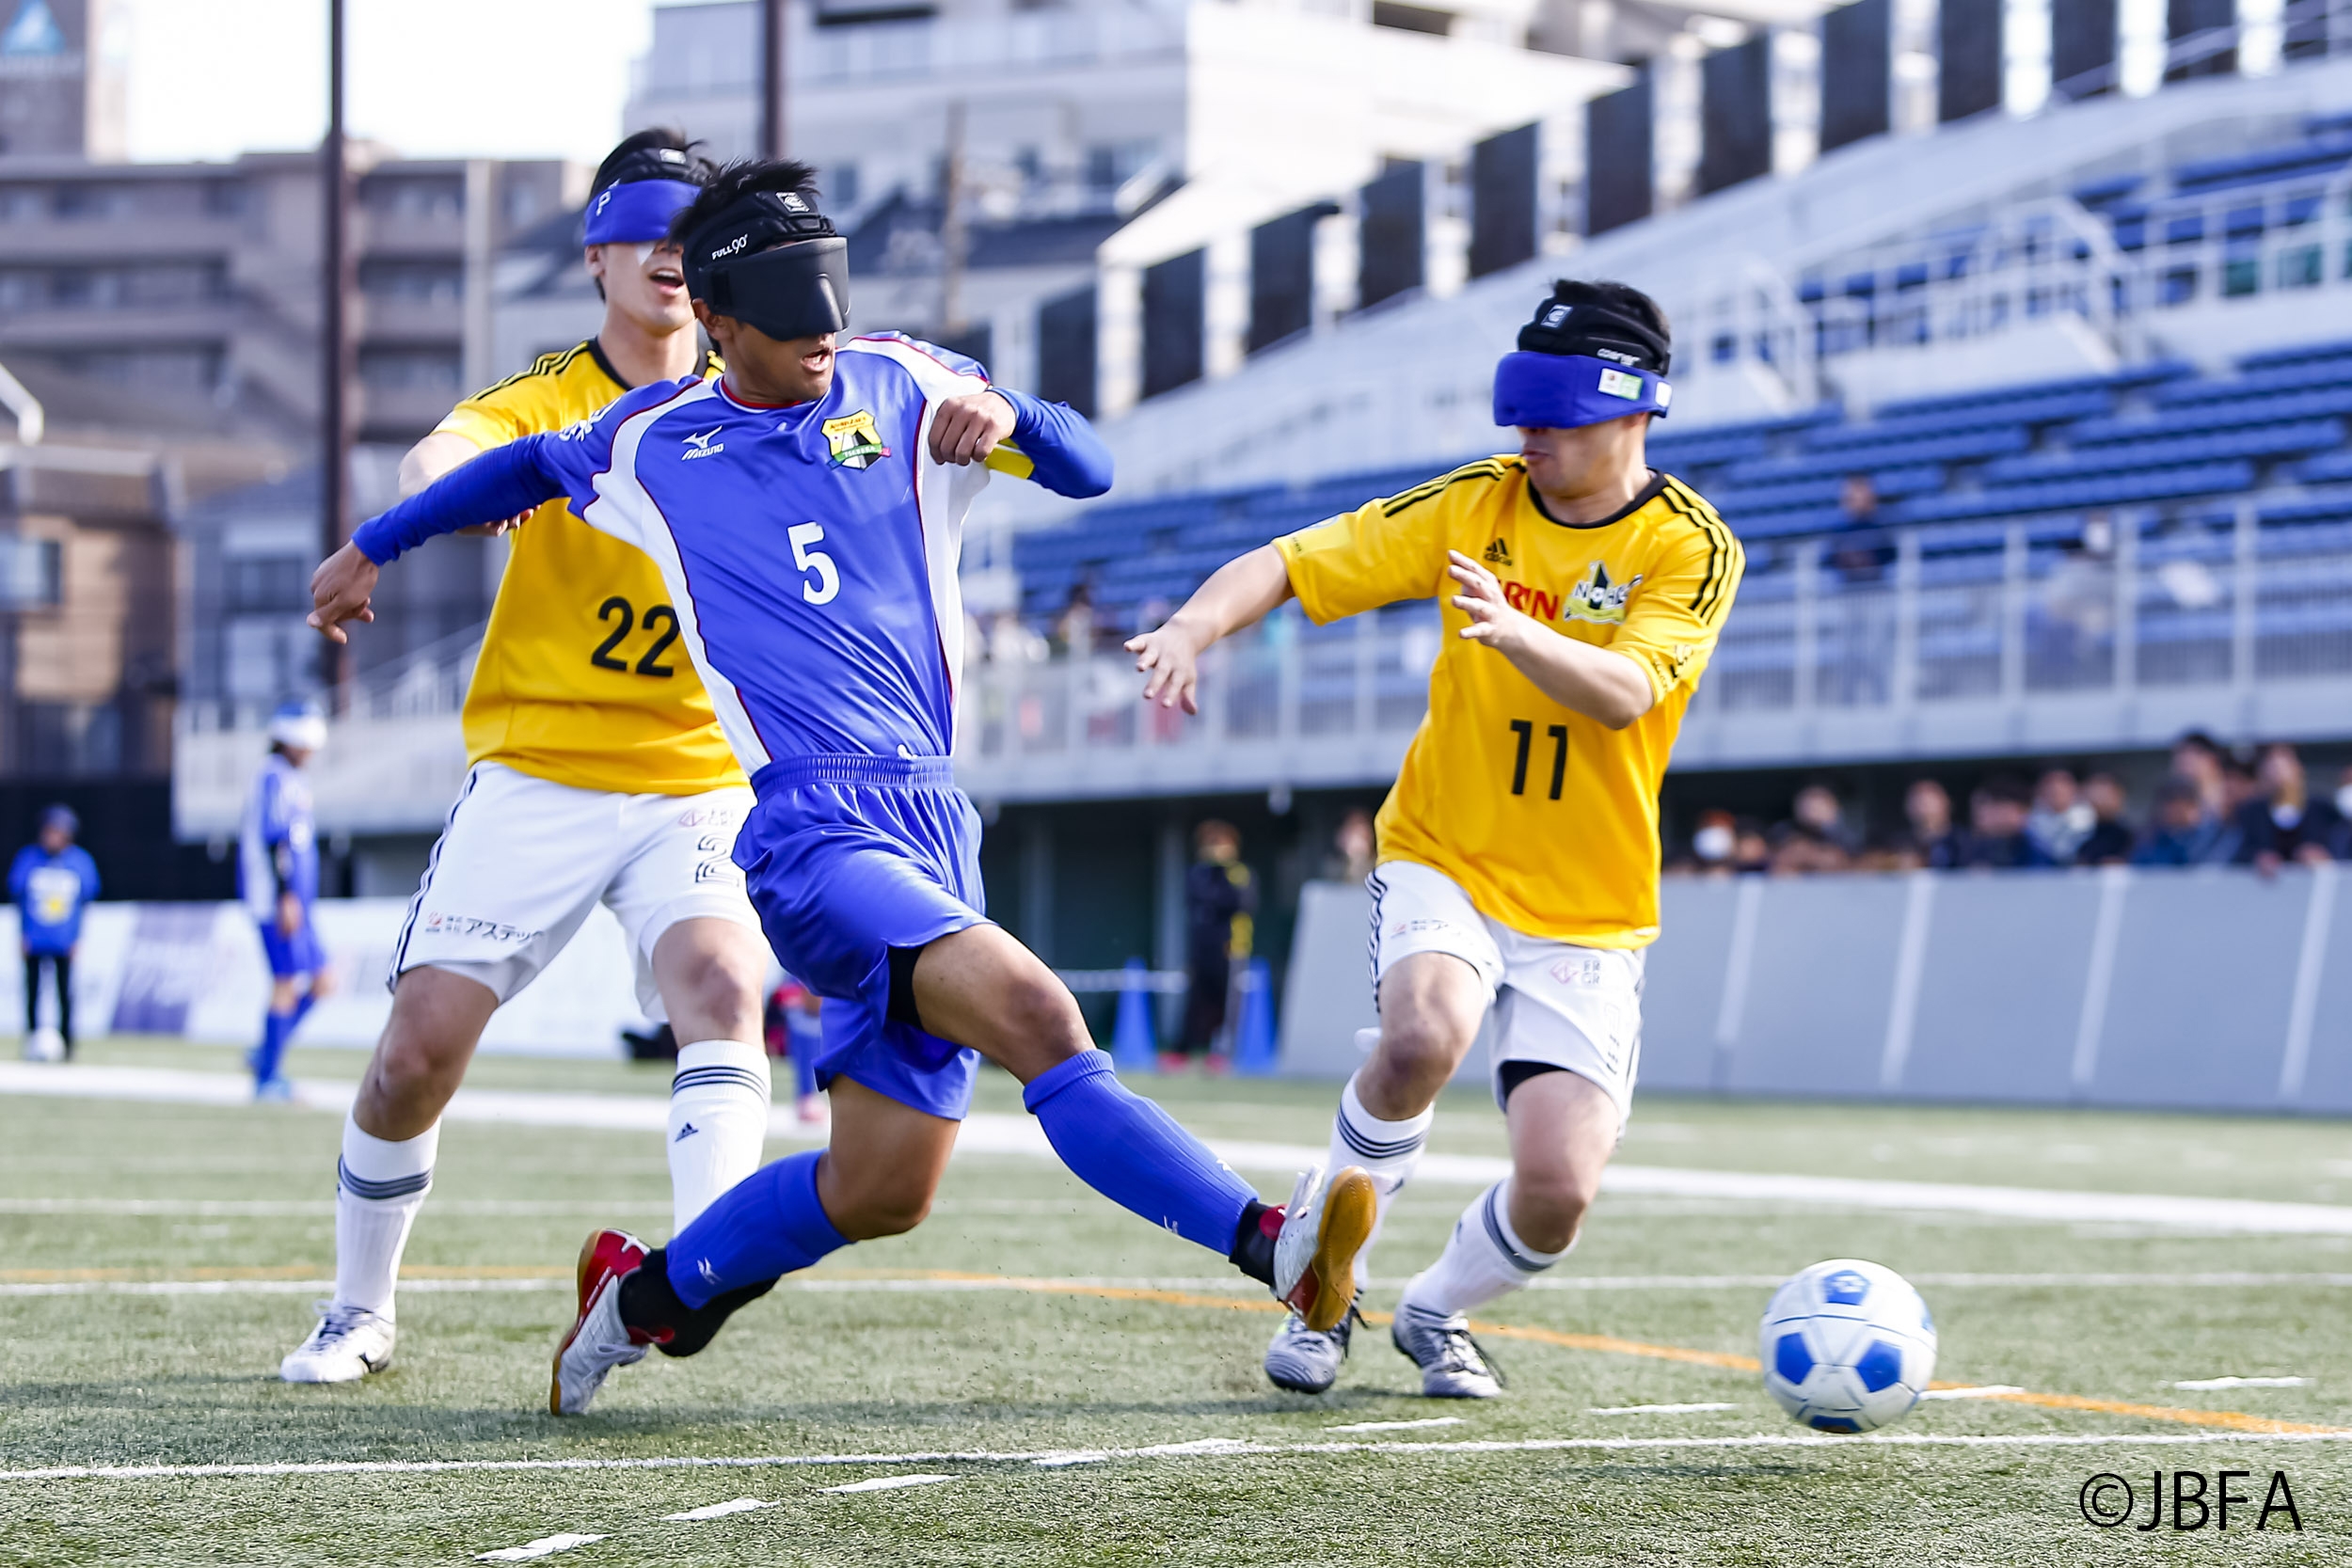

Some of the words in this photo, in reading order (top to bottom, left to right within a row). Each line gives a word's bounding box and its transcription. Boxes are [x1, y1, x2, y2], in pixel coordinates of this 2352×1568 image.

[787, 521, 840, 605] 5
[1496, 579, 1558, 621] RIN
[591, 595, 681, 677] 22
[1510, 719, 1567, 800] 11
